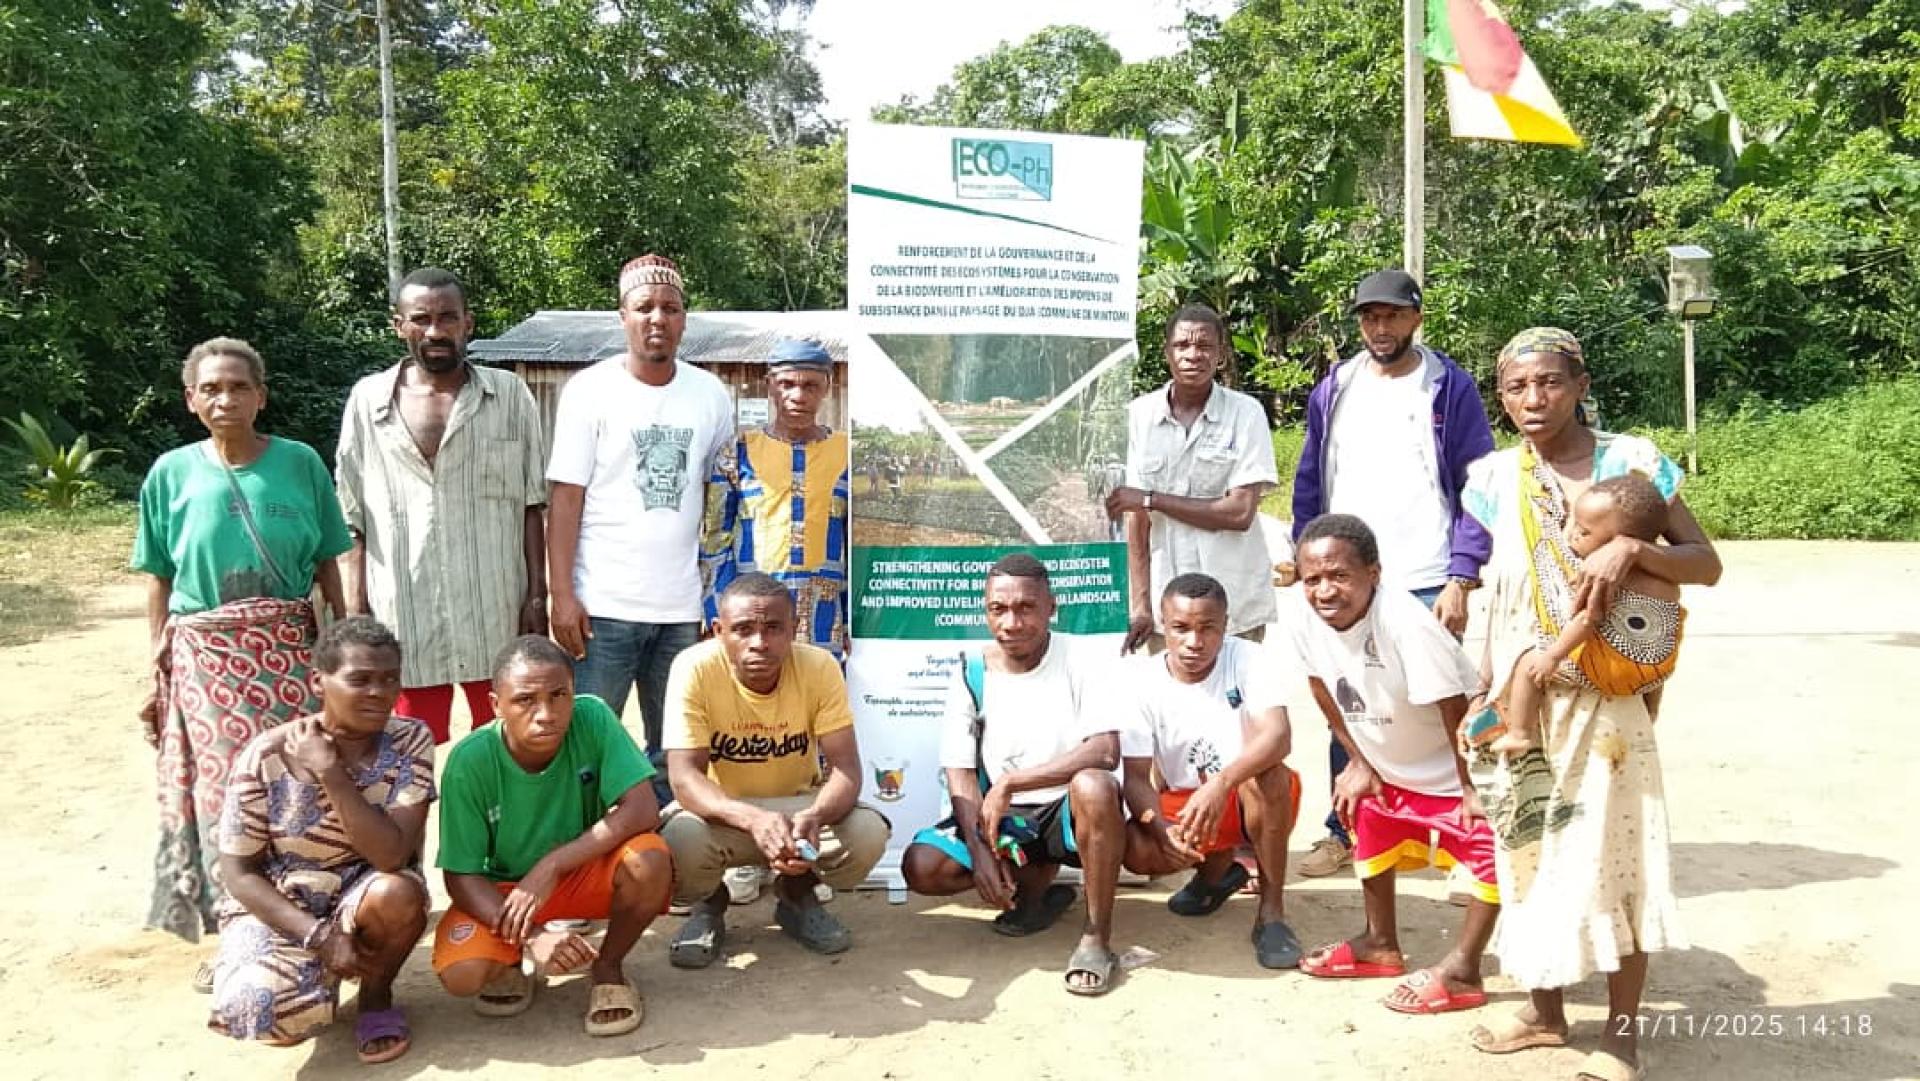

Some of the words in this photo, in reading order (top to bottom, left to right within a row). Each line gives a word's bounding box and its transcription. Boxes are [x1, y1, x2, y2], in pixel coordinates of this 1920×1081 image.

[897, 245, 967, 258] RENFORCEMENT
[970, 246, 981, 259] DE
[984, 246, 996, 259] LA
[999, 246, 1063, 260] GOUVERNANCE
[1023, 267, 1047, 279] POUR
[1048, 269, 1058, 280] LA
[1060, 269, 1120, 283] CONSERVATION
[876, 284, 889, 296] DE
[891, 284, 903, 296] LA
[967, 285, 976, 297] ET
[858, 304, 921, 316] SUBSISTANCE
[959, 305, 1000, 317] PAYSAGE
[1003, 305, 1016, 318] DU
[1018, 306, 1035, 318] DJA
[872, 561, 961, 574] STRENGTHENING
[868, 577, 945, 591] CONNECTIVITY
[946, 578, 970, 591] FOR
[861, 595, 884, 608] AND
[886, 595, 942, 609] IMPROVED
[709, 731, 809, 763] Yesterday
